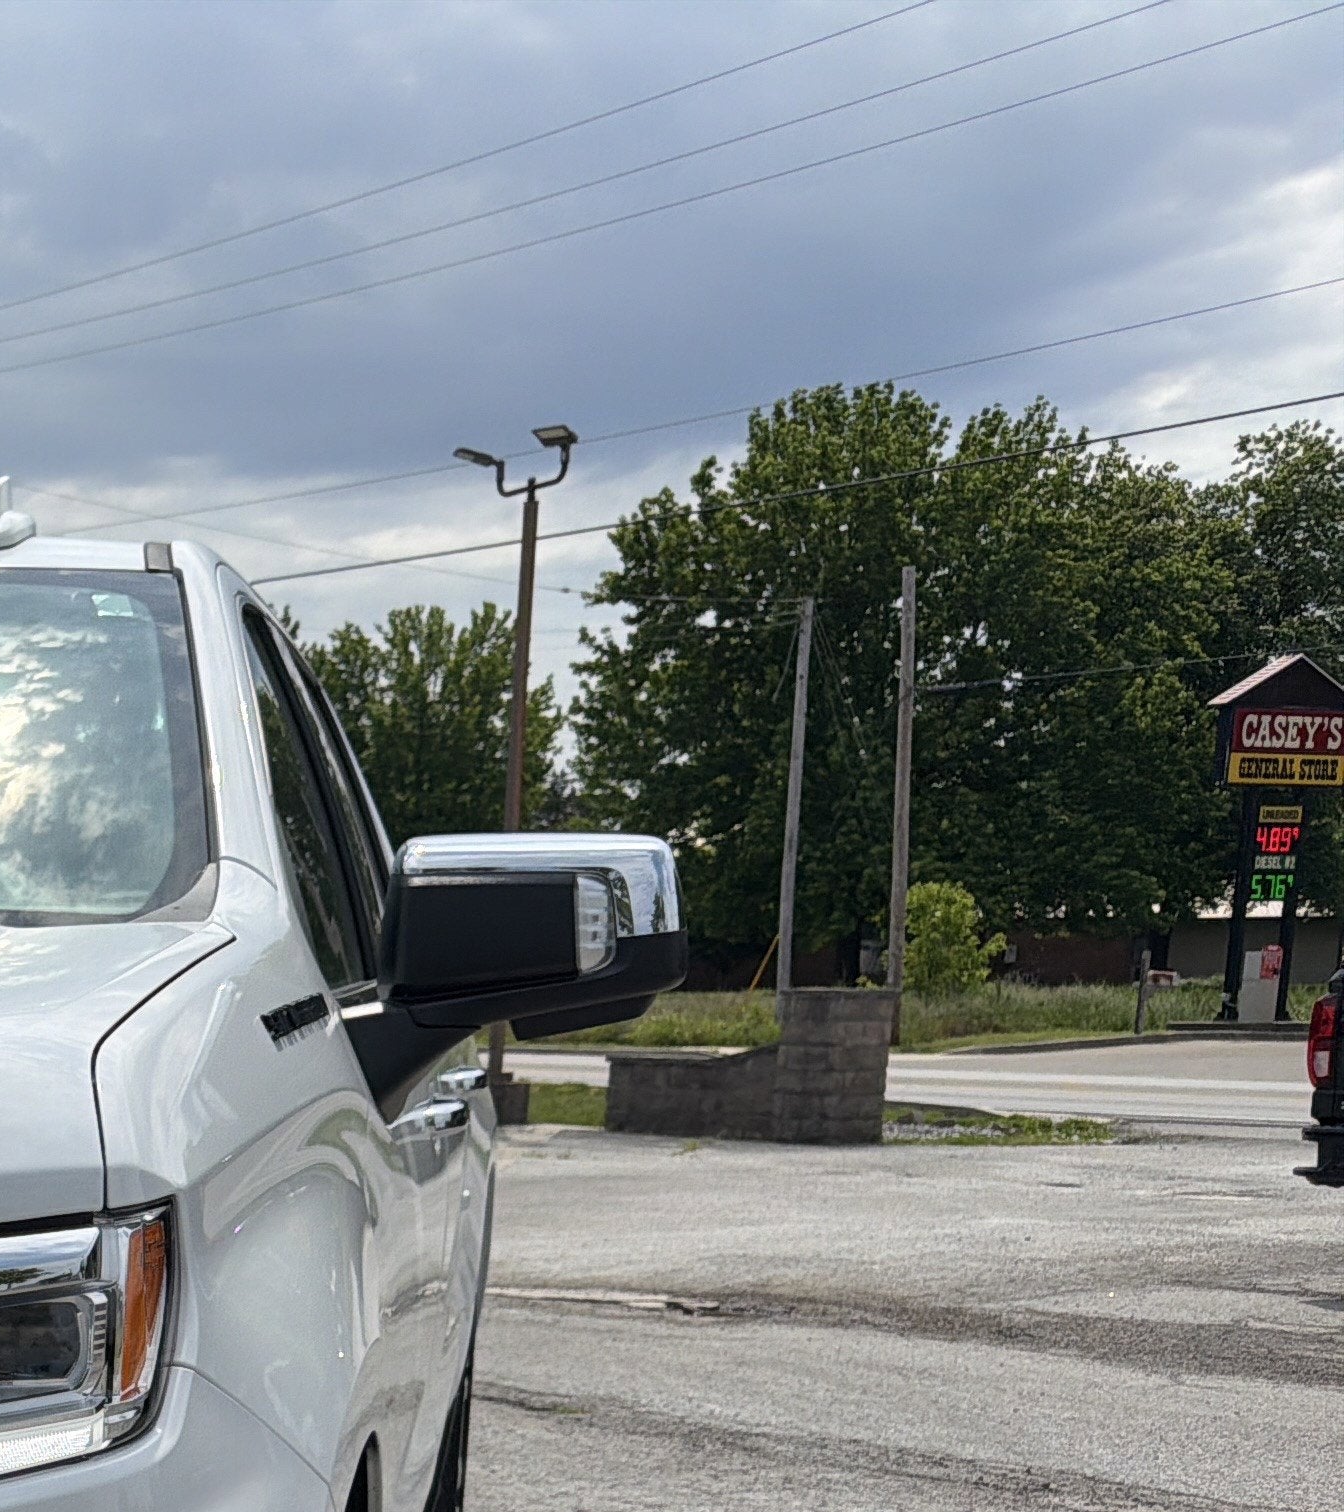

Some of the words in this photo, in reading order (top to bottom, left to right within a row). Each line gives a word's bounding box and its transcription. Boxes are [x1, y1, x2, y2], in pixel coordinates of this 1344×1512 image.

[1242, 713, 1343, 750] CASEY'S
[1239, 757, 1296, 780] GENERAL
[1298, 758, 1339, 781] STORE
[1254, 855, 1282, 870] DIESEL
